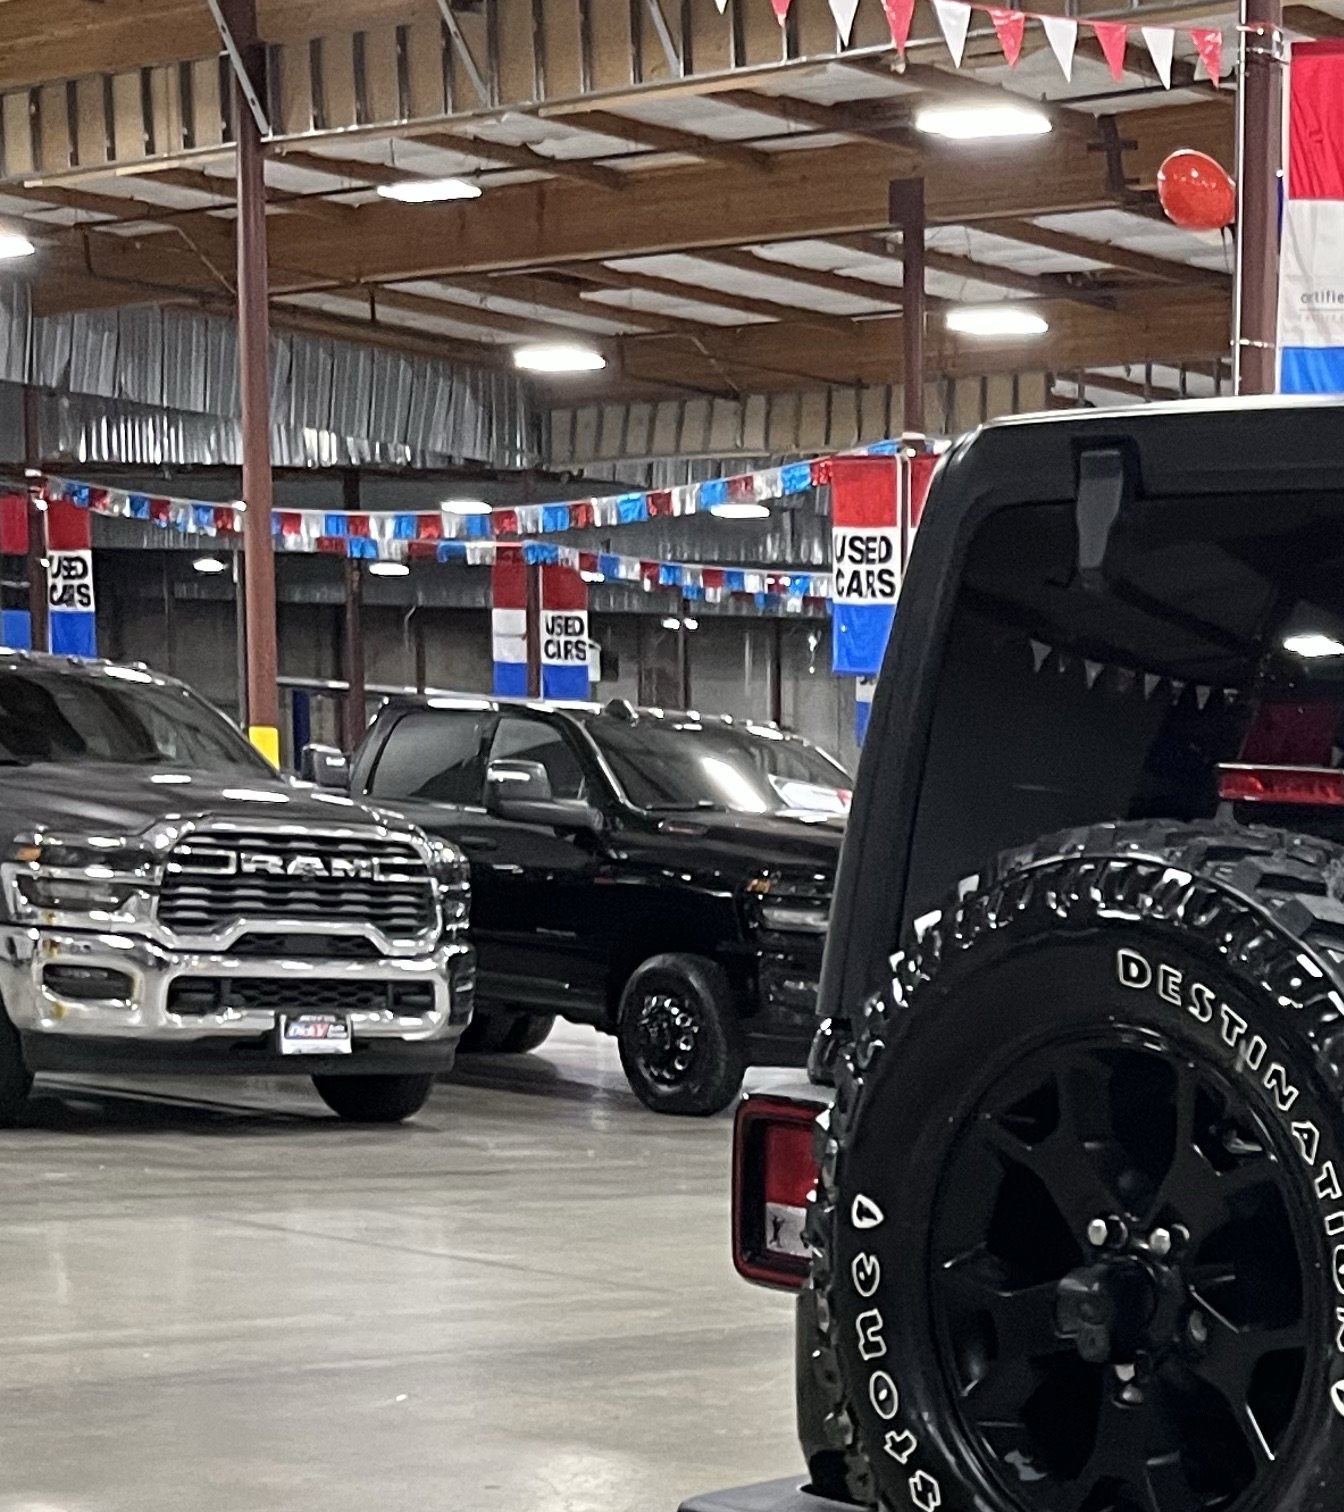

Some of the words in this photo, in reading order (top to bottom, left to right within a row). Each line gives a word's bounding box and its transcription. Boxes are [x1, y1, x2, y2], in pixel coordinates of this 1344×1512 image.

[834, 535, 893, 565] USED
[835, 568, 896, 599] CARS
[241, 853, 373, 878] RAM
